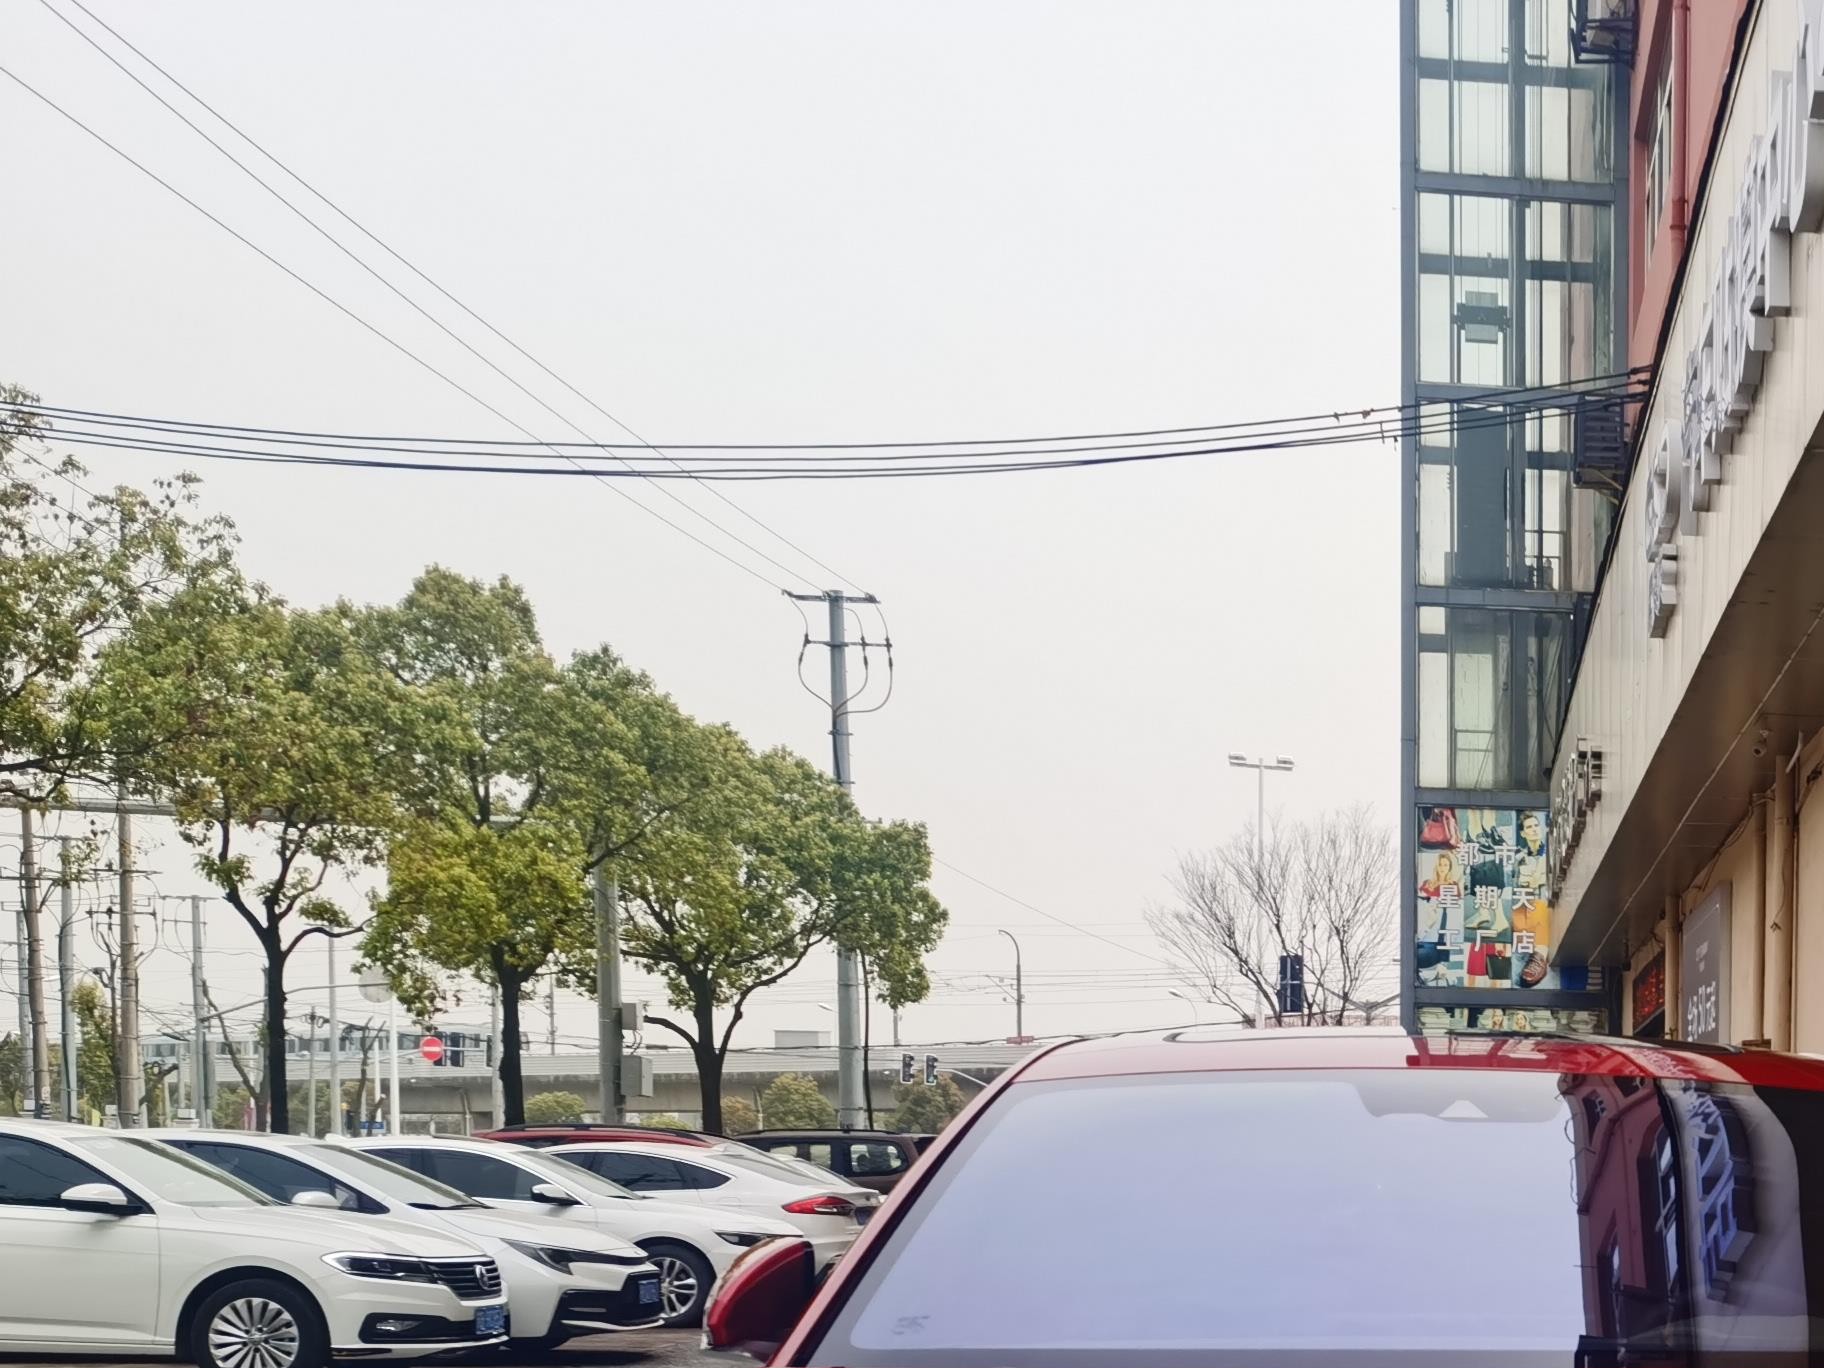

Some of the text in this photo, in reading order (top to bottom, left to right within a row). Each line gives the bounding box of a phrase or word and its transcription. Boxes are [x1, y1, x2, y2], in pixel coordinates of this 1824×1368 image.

[1456, 842, 1518, 866] 都市
[1438, 884, 1536, 911] 星期天
[1437, 929, 1536, 954] 工厂店
